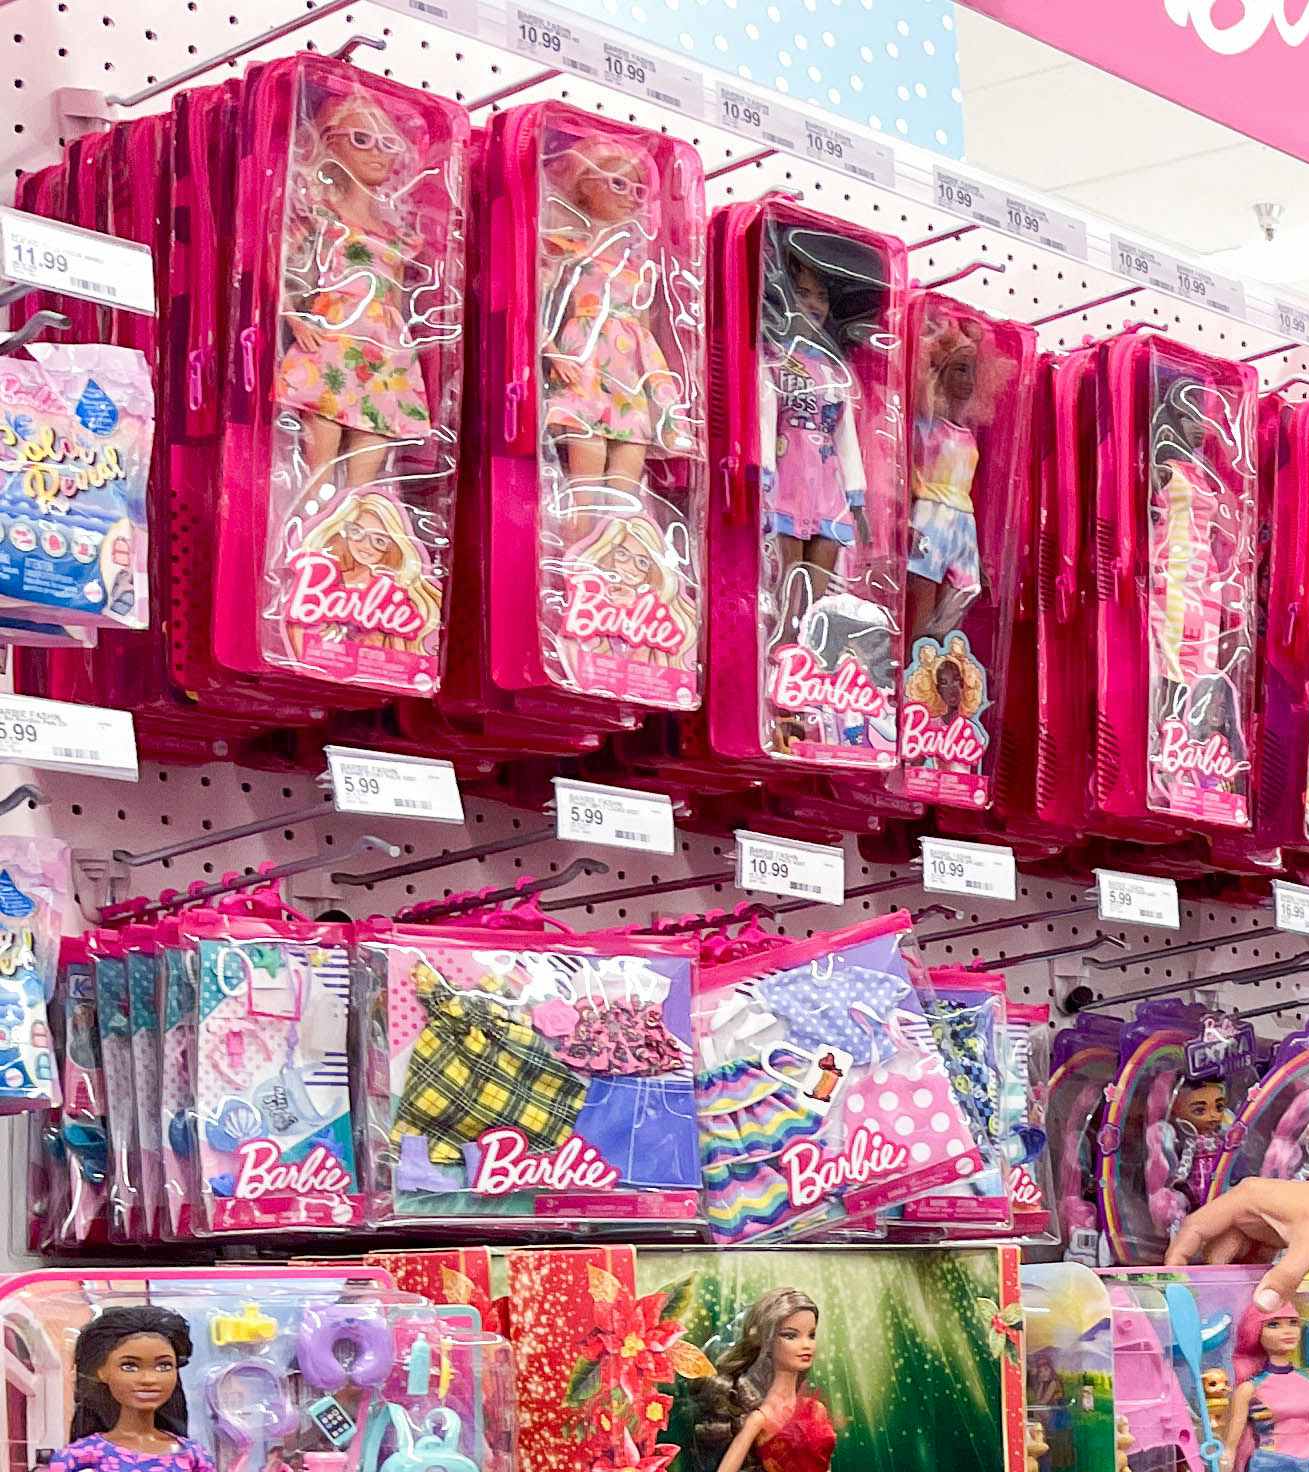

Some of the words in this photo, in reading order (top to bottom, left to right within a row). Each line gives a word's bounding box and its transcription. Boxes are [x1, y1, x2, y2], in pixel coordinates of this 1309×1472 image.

[518, 25, 562, 51] 10.99
[605, 55, 646, 83] 10.99
[721, 100, 761, 127] 10.99
[806, 133, 843, 158] 10.99
[937, 183, 972, 206] 10.99
[1006, 210, 1039, 232] 10.99
[12, 244, 68, 273] 11.99
[1118, 253, 1149, 274] 10.99
[1177, 274, 1206, 296] 10.99
[291, 556, 421, 630] Barbie
[567, 578, 683, 648] Barbie
[774, 650, 881, 714] Barbie
[902, 711, 984, 763] Barbie
[1161, 721, 1249, 778] Barbie
[343, 775, 380, 796] 5.99
[570, 805, 604, 826] 5.99
[749, 857, 789, 879] 10.99
[930, 859, 964, 878] 10.99
[235, 1142, 348, 1199] Barbie
[478, 1133, 617, 1194] Barbie
[785, 1130, 907, 1208] Barbie
[1011, 1169, 1042, 1205] bie
